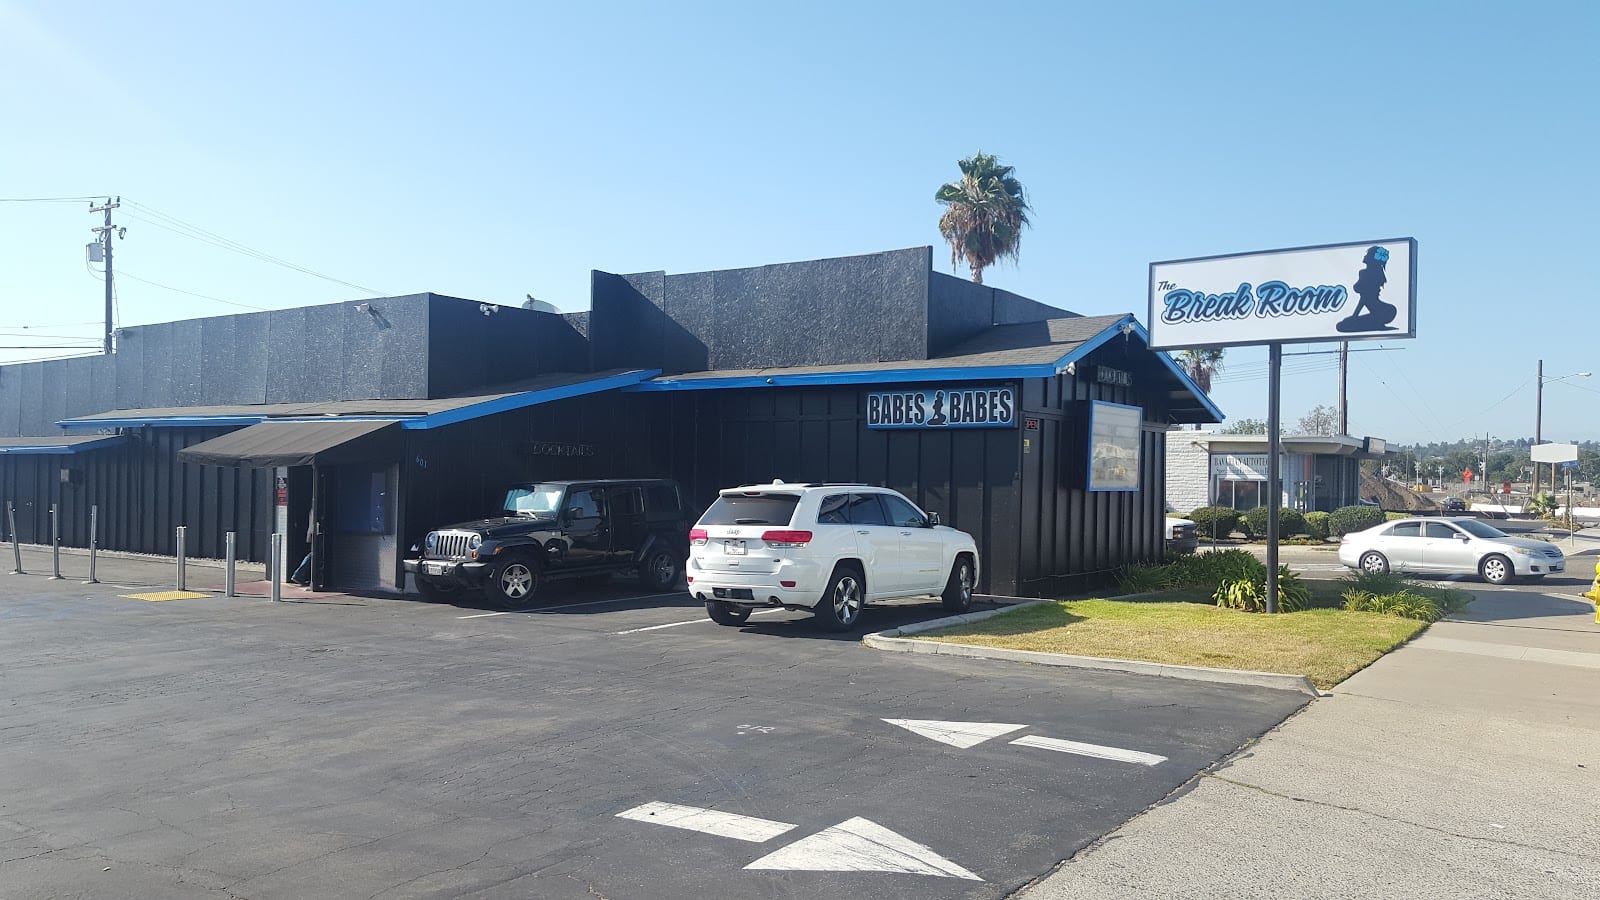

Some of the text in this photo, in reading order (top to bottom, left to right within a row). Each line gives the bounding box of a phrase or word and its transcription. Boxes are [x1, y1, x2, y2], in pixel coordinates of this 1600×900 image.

[1158, 280, 1177, 291] The
[1161, 281, 1348, 324] Break Room
[868, 389, 1012, 426] BABES BABES
[416, 455, 427, 469] 601
